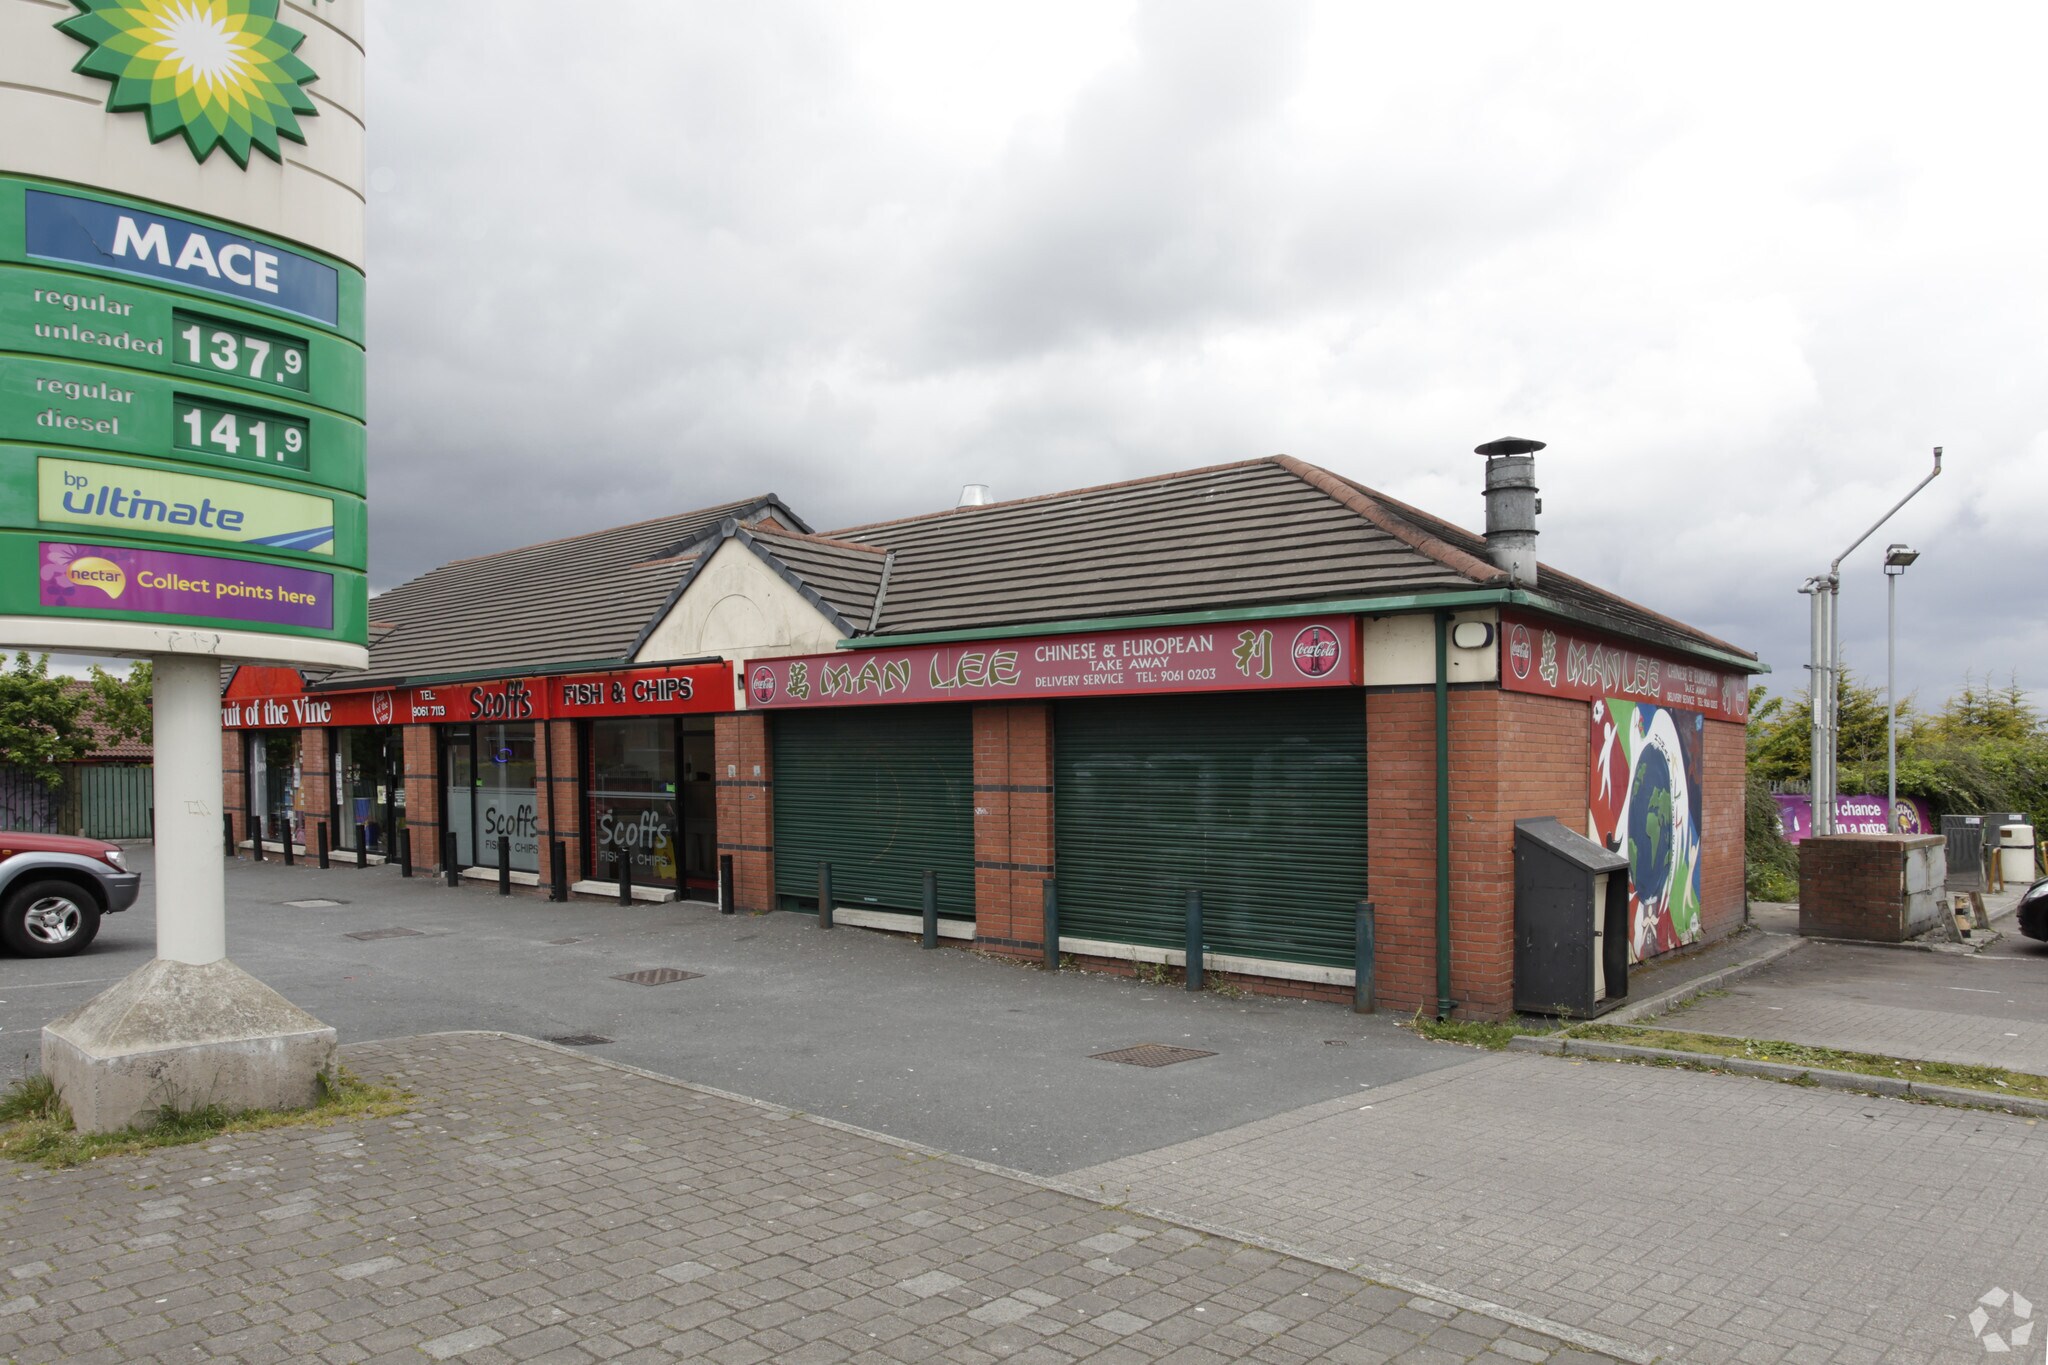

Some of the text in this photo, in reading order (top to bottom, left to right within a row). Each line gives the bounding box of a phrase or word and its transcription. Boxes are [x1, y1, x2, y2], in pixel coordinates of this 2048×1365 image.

[112, 215, 279, 294] MACE
[34, 288, 134, 316] regular
[34, 323, 163, 356] unleaded
[182, 325, 302, 382] 137.9
[36, 377, 135, 404] regular
[36, 409, 119, 435] diesel
[183, 409, 302, 462] 141.9
[64, 471, 88, 489] bp
[62, 485, 244, 532] ultimate
[71, 567, 121, 584] nectar
[137, 571, 316, 606] Collect points here
[1034, 634, 1214, 663] CHINESE & EUROPEAN
[1294, 641, 1337, 659] Coca-Cola
[819, 648, 1022, 697] MAN LEE
[1035, 667, 1216, 688] DELIVERY SERVICE TEL: 9061 0203
[1089, 656, 1170, 672] TAKE AWAY
[1567, 636, 1661, 698] MAN LEE
[469, 679, 533, 720] Scoffs
[563, 677, 694, 706] FISH & CHIPS
[245, 699, 260, 726] of
[264, 699, 289, 725] the
[292, 696, 332, 724] Vine
[413, 705, 446, 717] 9061 7113
[485, 804, 538, 838] Scoffs
[1841, 800, 1881, 816] chance
[601, 810, 668, 849] Scoffs
[1850, 823, 1858, 834] a
[1859, 819, 1887, 834] prize
[485, 839, 499, 850] FIS
[514, 842, 538, 854] CHIPS
[637, 853, 668, 867] CHIPS
